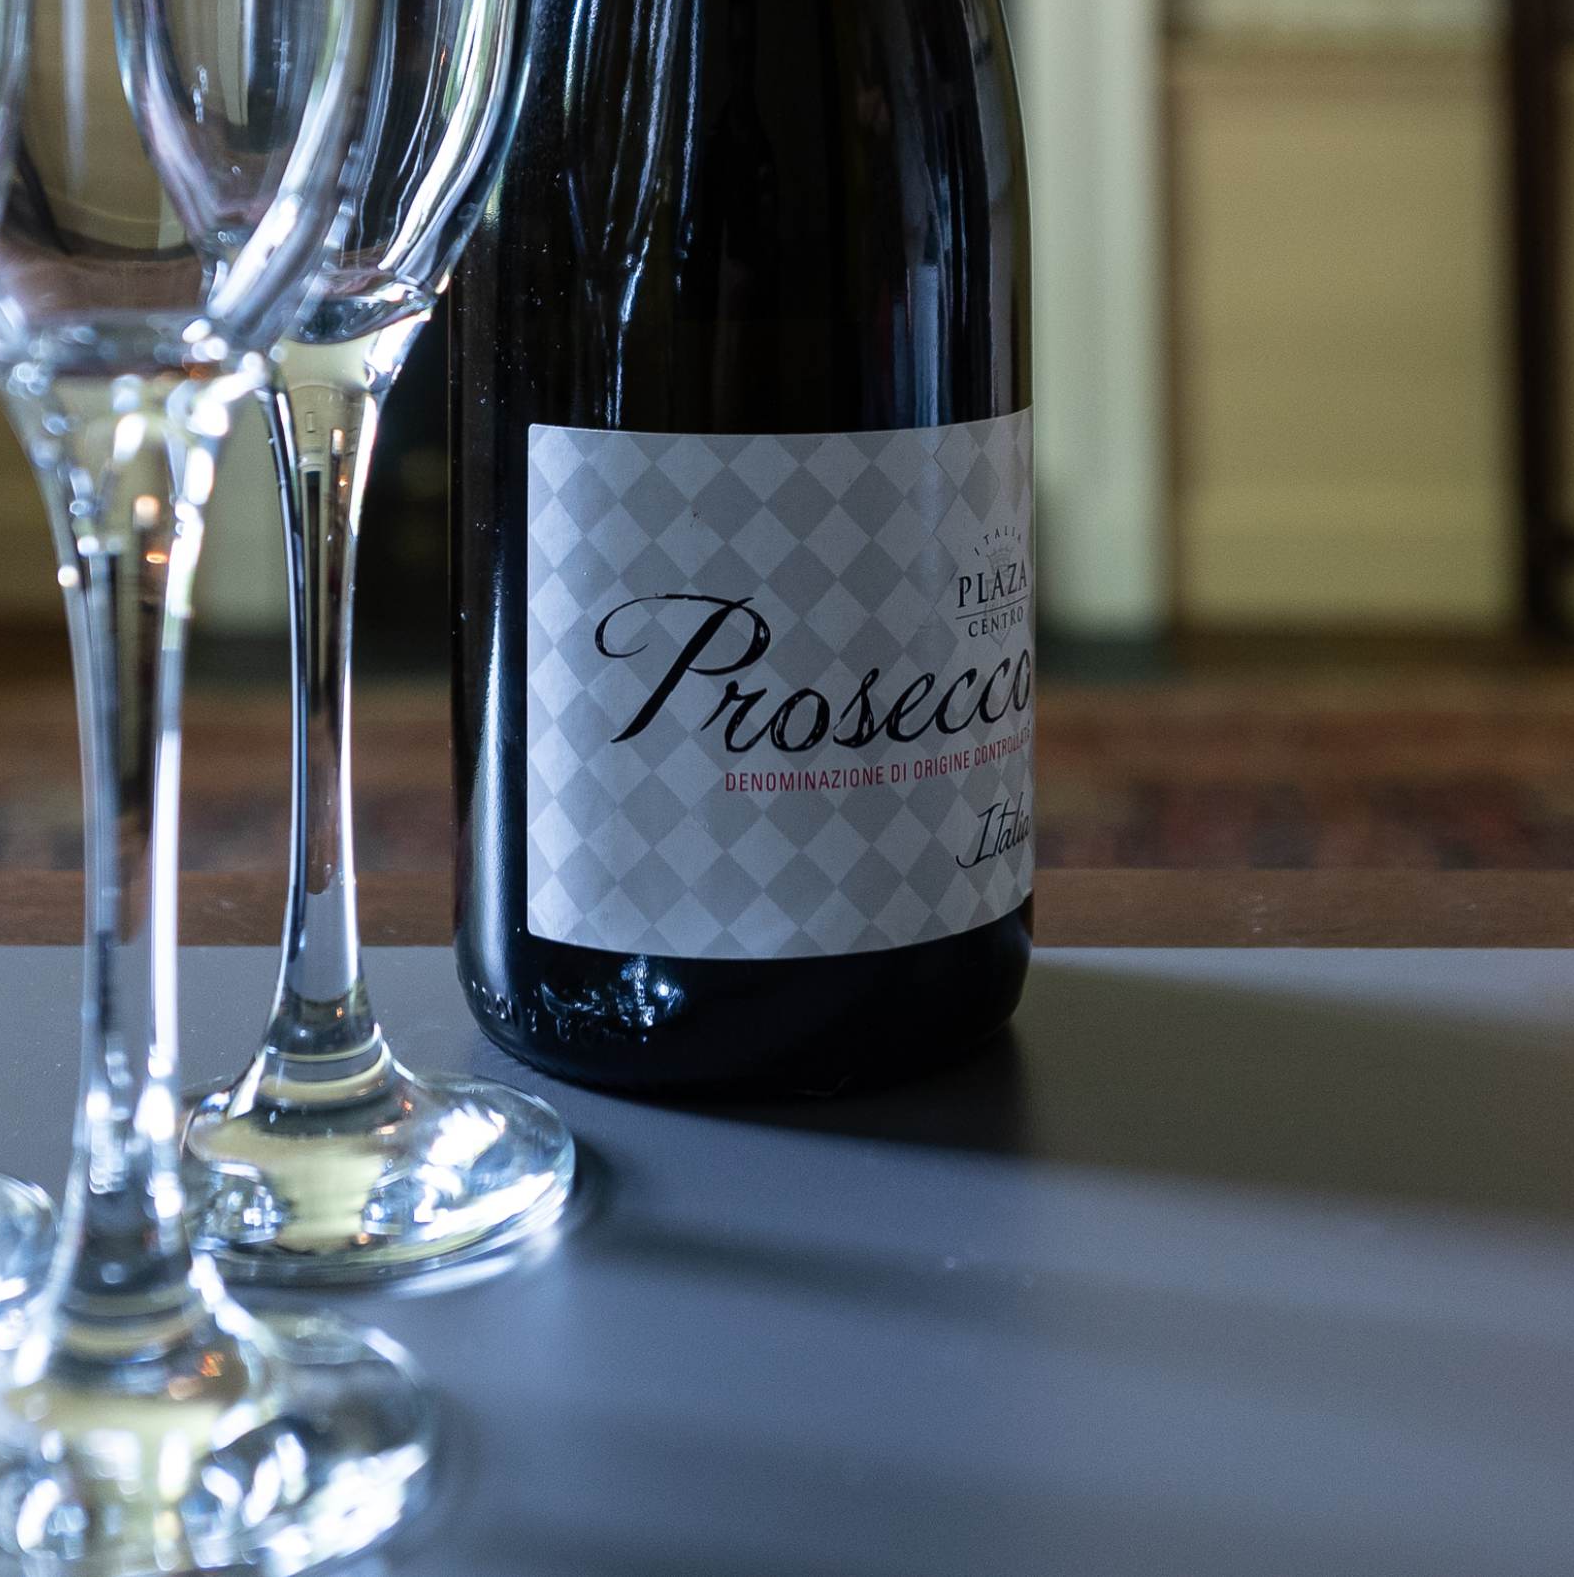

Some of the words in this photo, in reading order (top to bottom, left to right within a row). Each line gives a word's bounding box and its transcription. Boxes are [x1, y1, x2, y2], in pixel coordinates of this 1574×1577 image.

[957, 559, 1027, 609] PLAZA
[968, 606, 1024, 638] CENTRO
[594, 593, 1031, 753] Prosecco
[724, 765, 885, 793] DENOMINAZIONE
[891, 762, 907, 783] DI
[913, 749, 970, 780] ORIGINE
